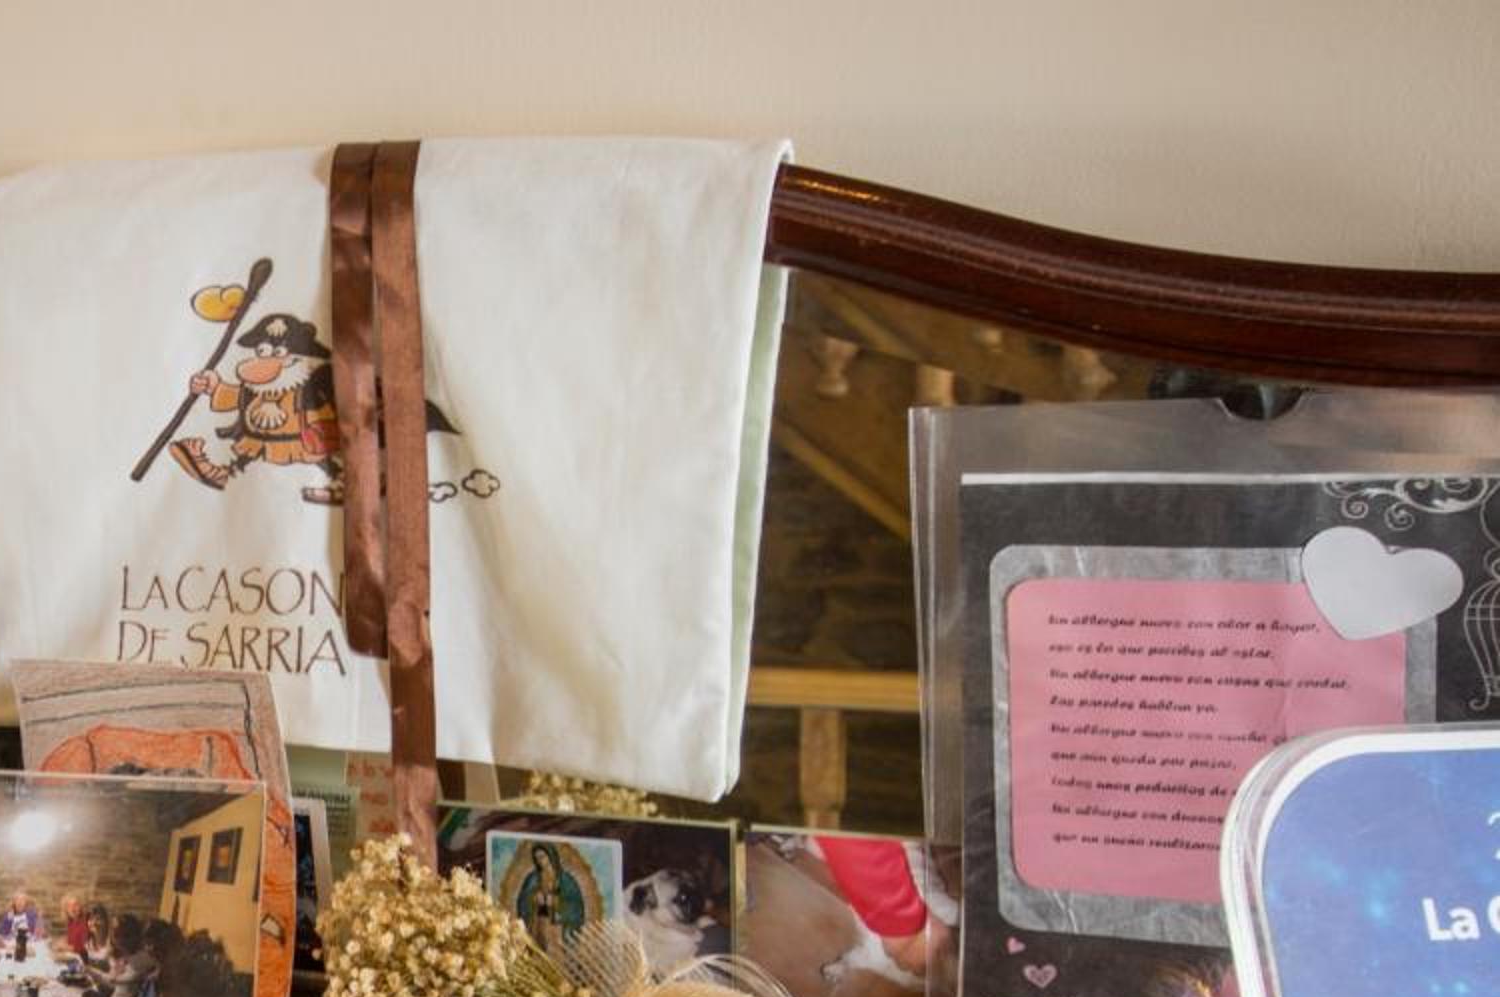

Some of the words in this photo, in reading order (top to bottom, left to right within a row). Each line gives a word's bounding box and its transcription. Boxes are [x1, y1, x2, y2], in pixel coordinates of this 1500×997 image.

[120, 564, 169, 611] LA
[1071, 614, 1135, 629] albergue
[180, 622, 347, 677] SARRIA
[1072, 668, 1136, 683] albergue
[1078, 697, 1135, 711] paredes
[1073, 723, 1137, 739] albergue
[1075, 804, 1138, 820] albergue
[1422, 897, 1480, 941] La
